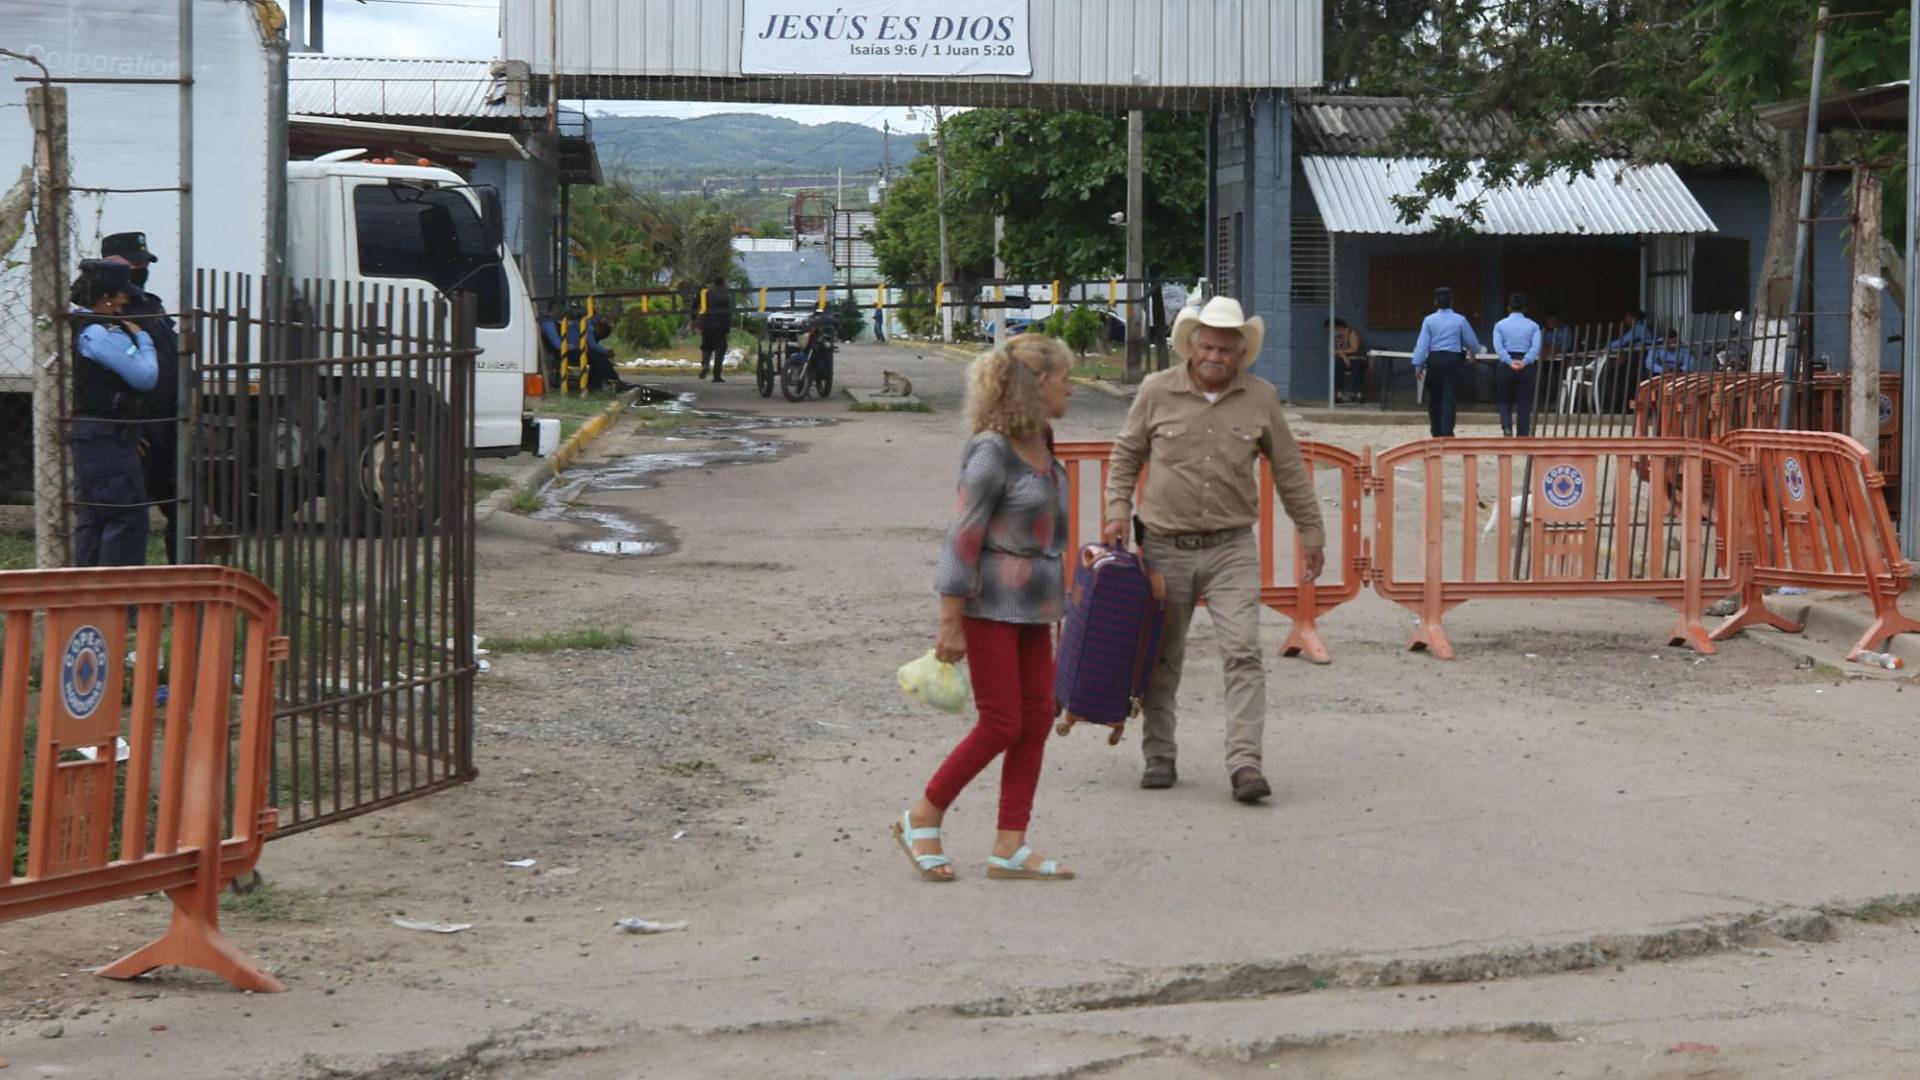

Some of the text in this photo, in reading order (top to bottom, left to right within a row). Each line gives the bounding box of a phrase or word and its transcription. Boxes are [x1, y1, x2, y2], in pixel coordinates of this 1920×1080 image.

[758, 7, 1014, 41] JESÚS ES DIOS
[850, 43, 1015, 58] Isaías 9:6 / 1 Juan 5:20
[64, 631, 106, 668] COPECO
